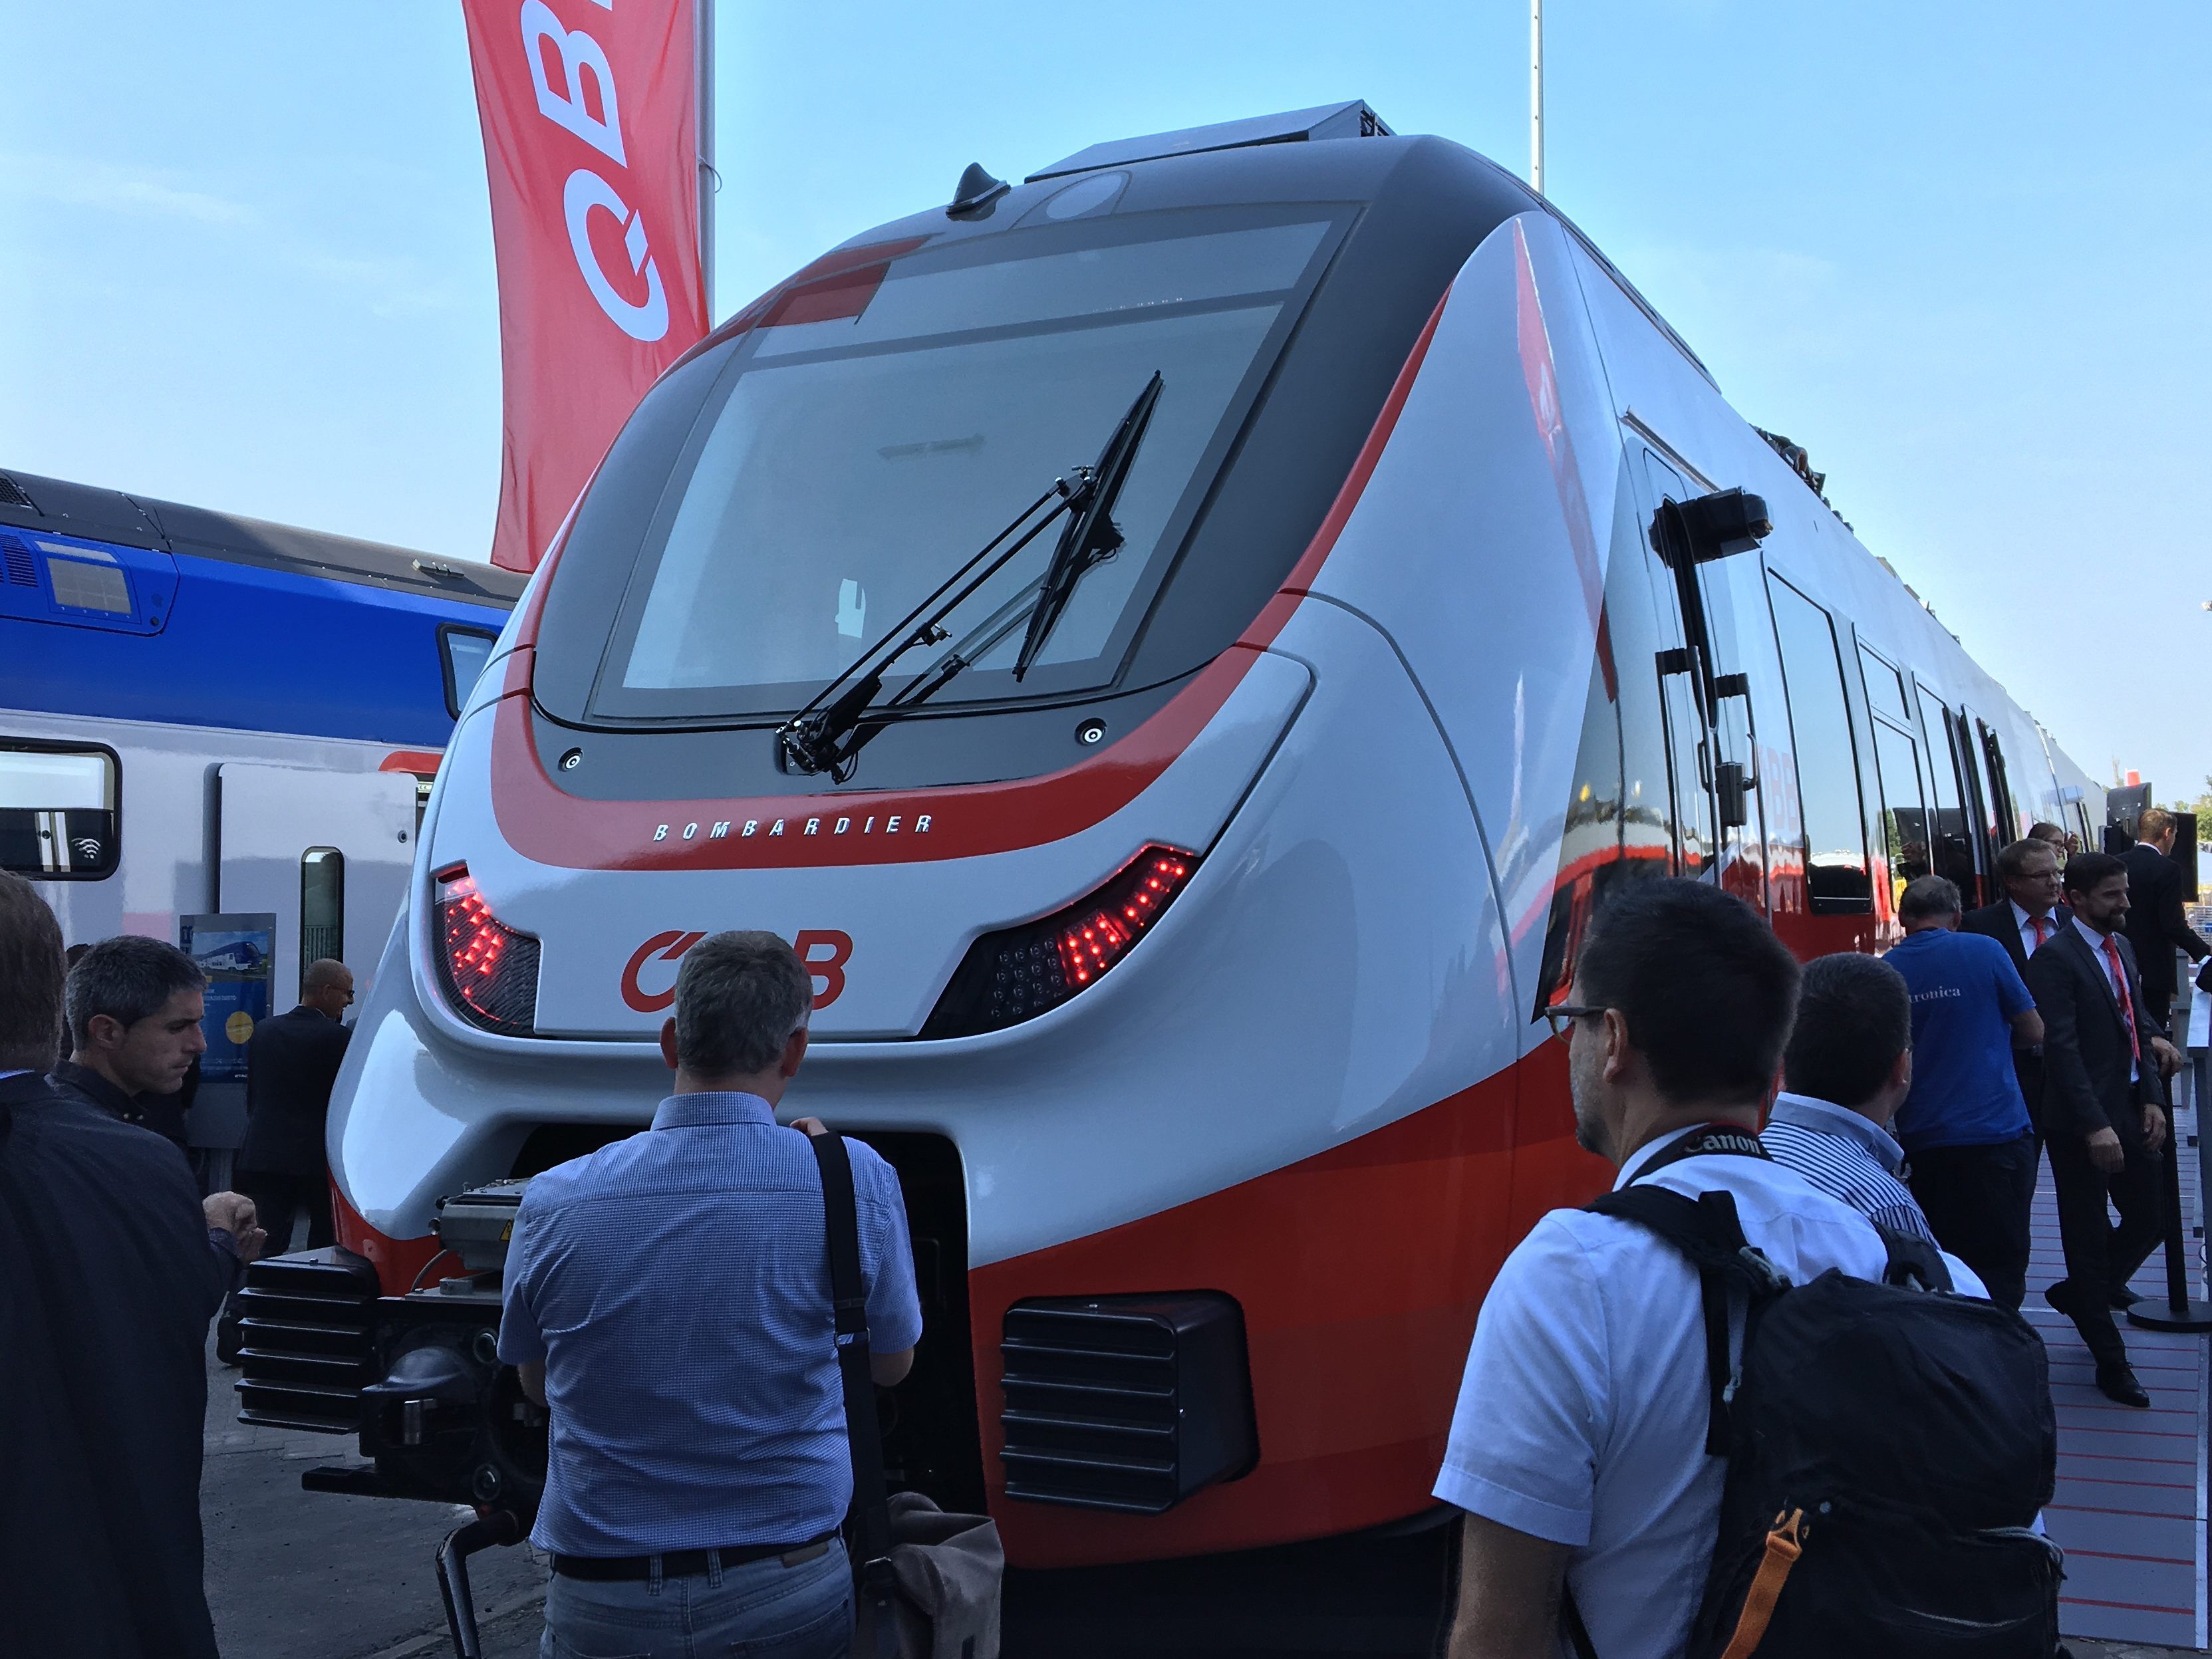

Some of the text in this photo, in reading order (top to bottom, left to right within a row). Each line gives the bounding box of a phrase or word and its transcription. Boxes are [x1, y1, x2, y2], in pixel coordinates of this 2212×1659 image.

[654, 815, 931, 841] BOMBARDIER
[621, 929, 853, 1013] ÖB
[1684, 1134, 1761, 1155] Canon
